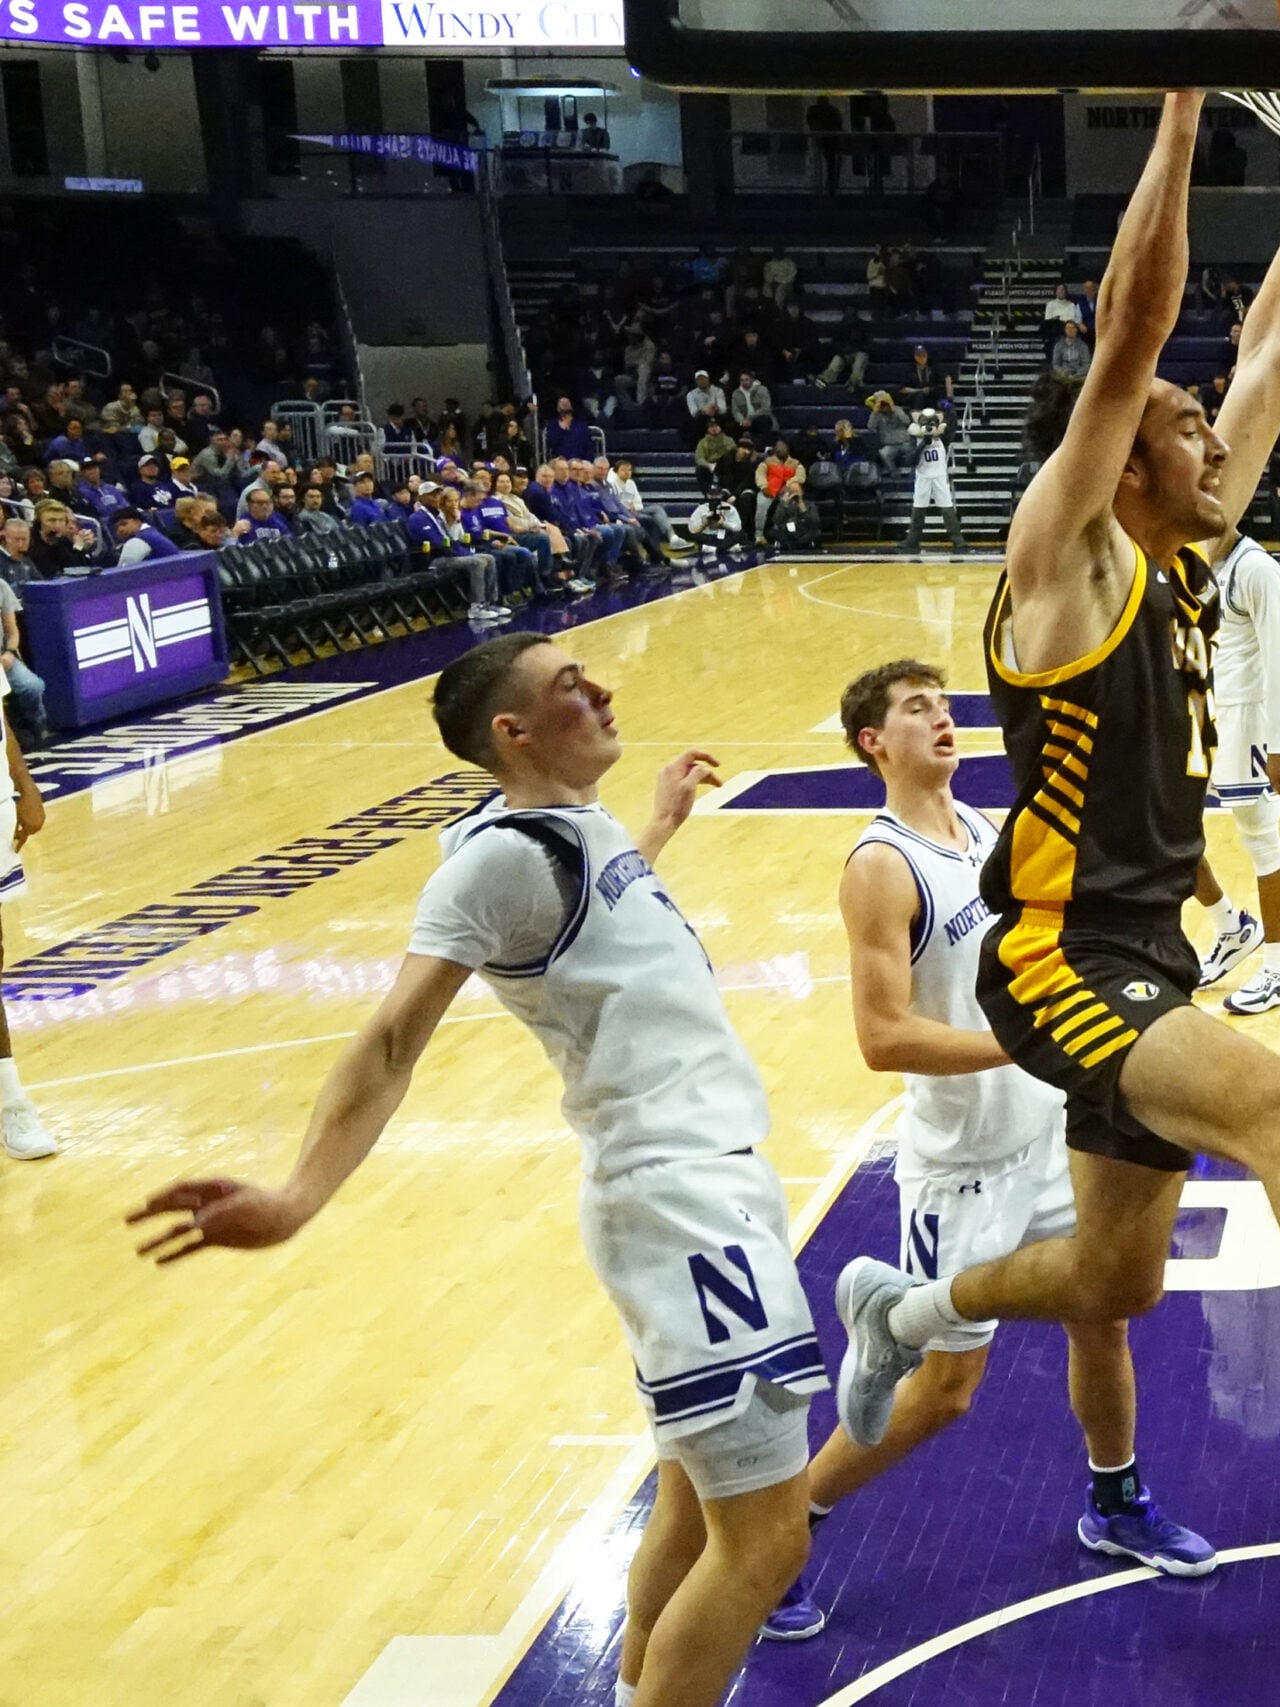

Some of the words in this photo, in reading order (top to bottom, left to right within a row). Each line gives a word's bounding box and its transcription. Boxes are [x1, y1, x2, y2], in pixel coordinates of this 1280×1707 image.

[63, 3, 200, 41] SAFE
[222, 5, 358, 41] WITH
[923, 449, 939, 462] 00
[126, 592, 158, 674] N
[906, 1208, 940, 1281] N
[686, 1245, 770, 1345] N
